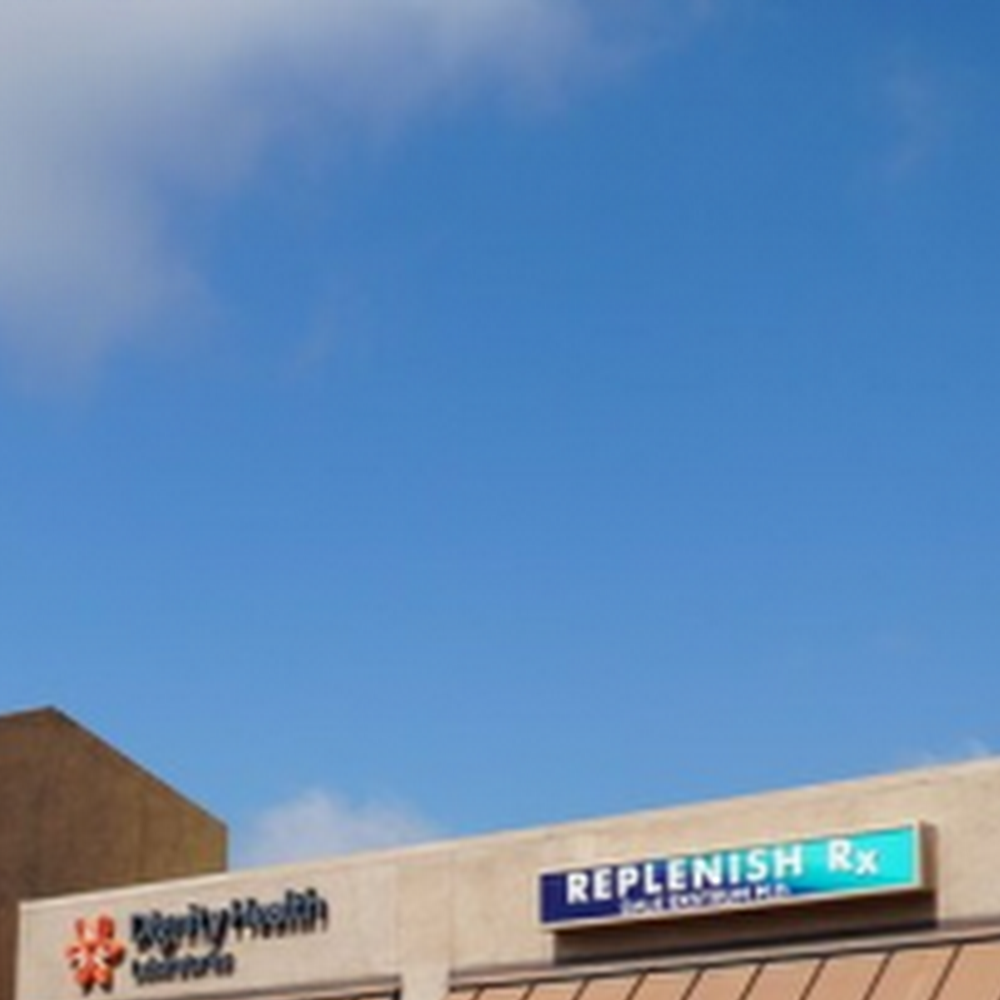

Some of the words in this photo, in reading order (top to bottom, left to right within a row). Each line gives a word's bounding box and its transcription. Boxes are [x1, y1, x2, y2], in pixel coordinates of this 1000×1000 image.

[566, 844, 803, 904] REPLENISH
[828, 838, 878, 876] Rx
[131, 902, 230, 956] Dignity
[231, 888, 329, 942] Health
